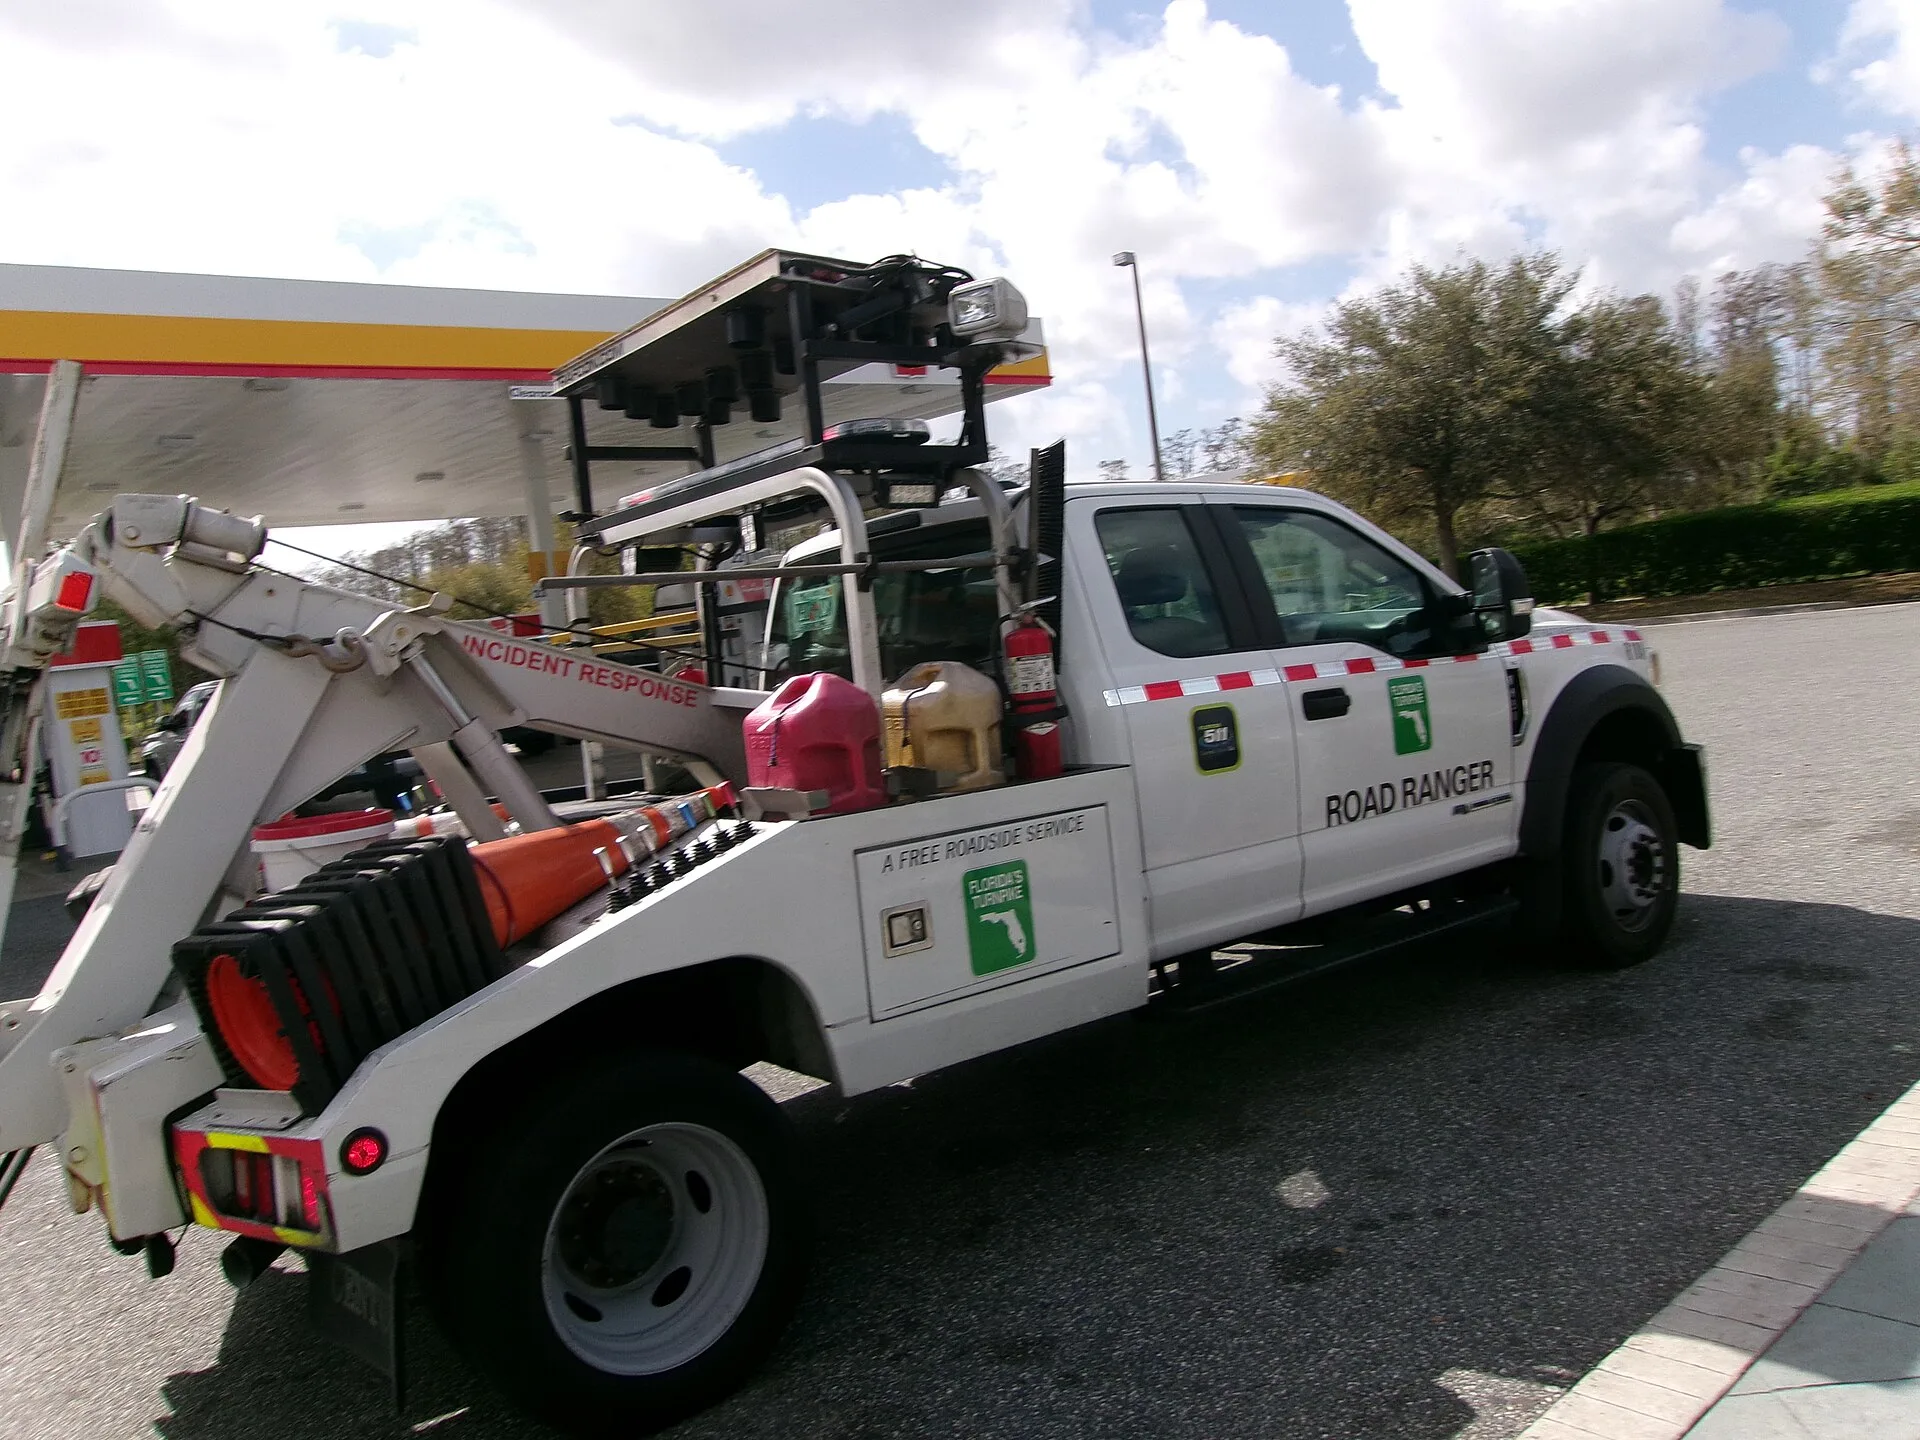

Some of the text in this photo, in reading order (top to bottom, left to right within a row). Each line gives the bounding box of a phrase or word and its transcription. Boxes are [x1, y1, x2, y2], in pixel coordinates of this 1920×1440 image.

[463, 635, 699, 708] INCIDENT RESPONSE
[1203, 726, 1229, 744] 511
[1326, 783, 1396, 828] ROAD
[1402, 760, 1494, 808] RANGER
[881, 815, 1085, 873] A FREE ROADSIDE SERVICE
